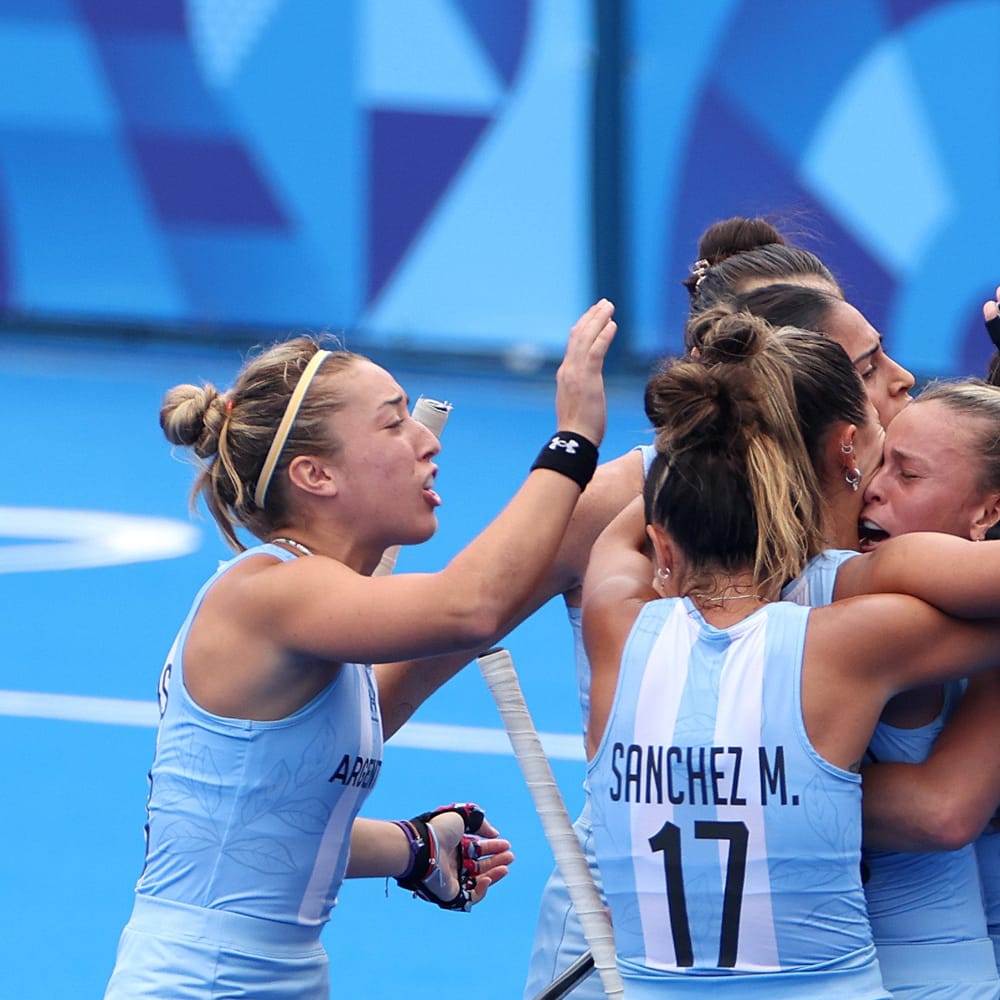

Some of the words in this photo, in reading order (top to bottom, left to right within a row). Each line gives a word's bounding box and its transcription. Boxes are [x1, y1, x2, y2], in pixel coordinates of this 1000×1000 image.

[609, 742, 747, 806] SANCHEZ
[758, 745, 800, 806] M.
[647, 820, 749, 968] 17
